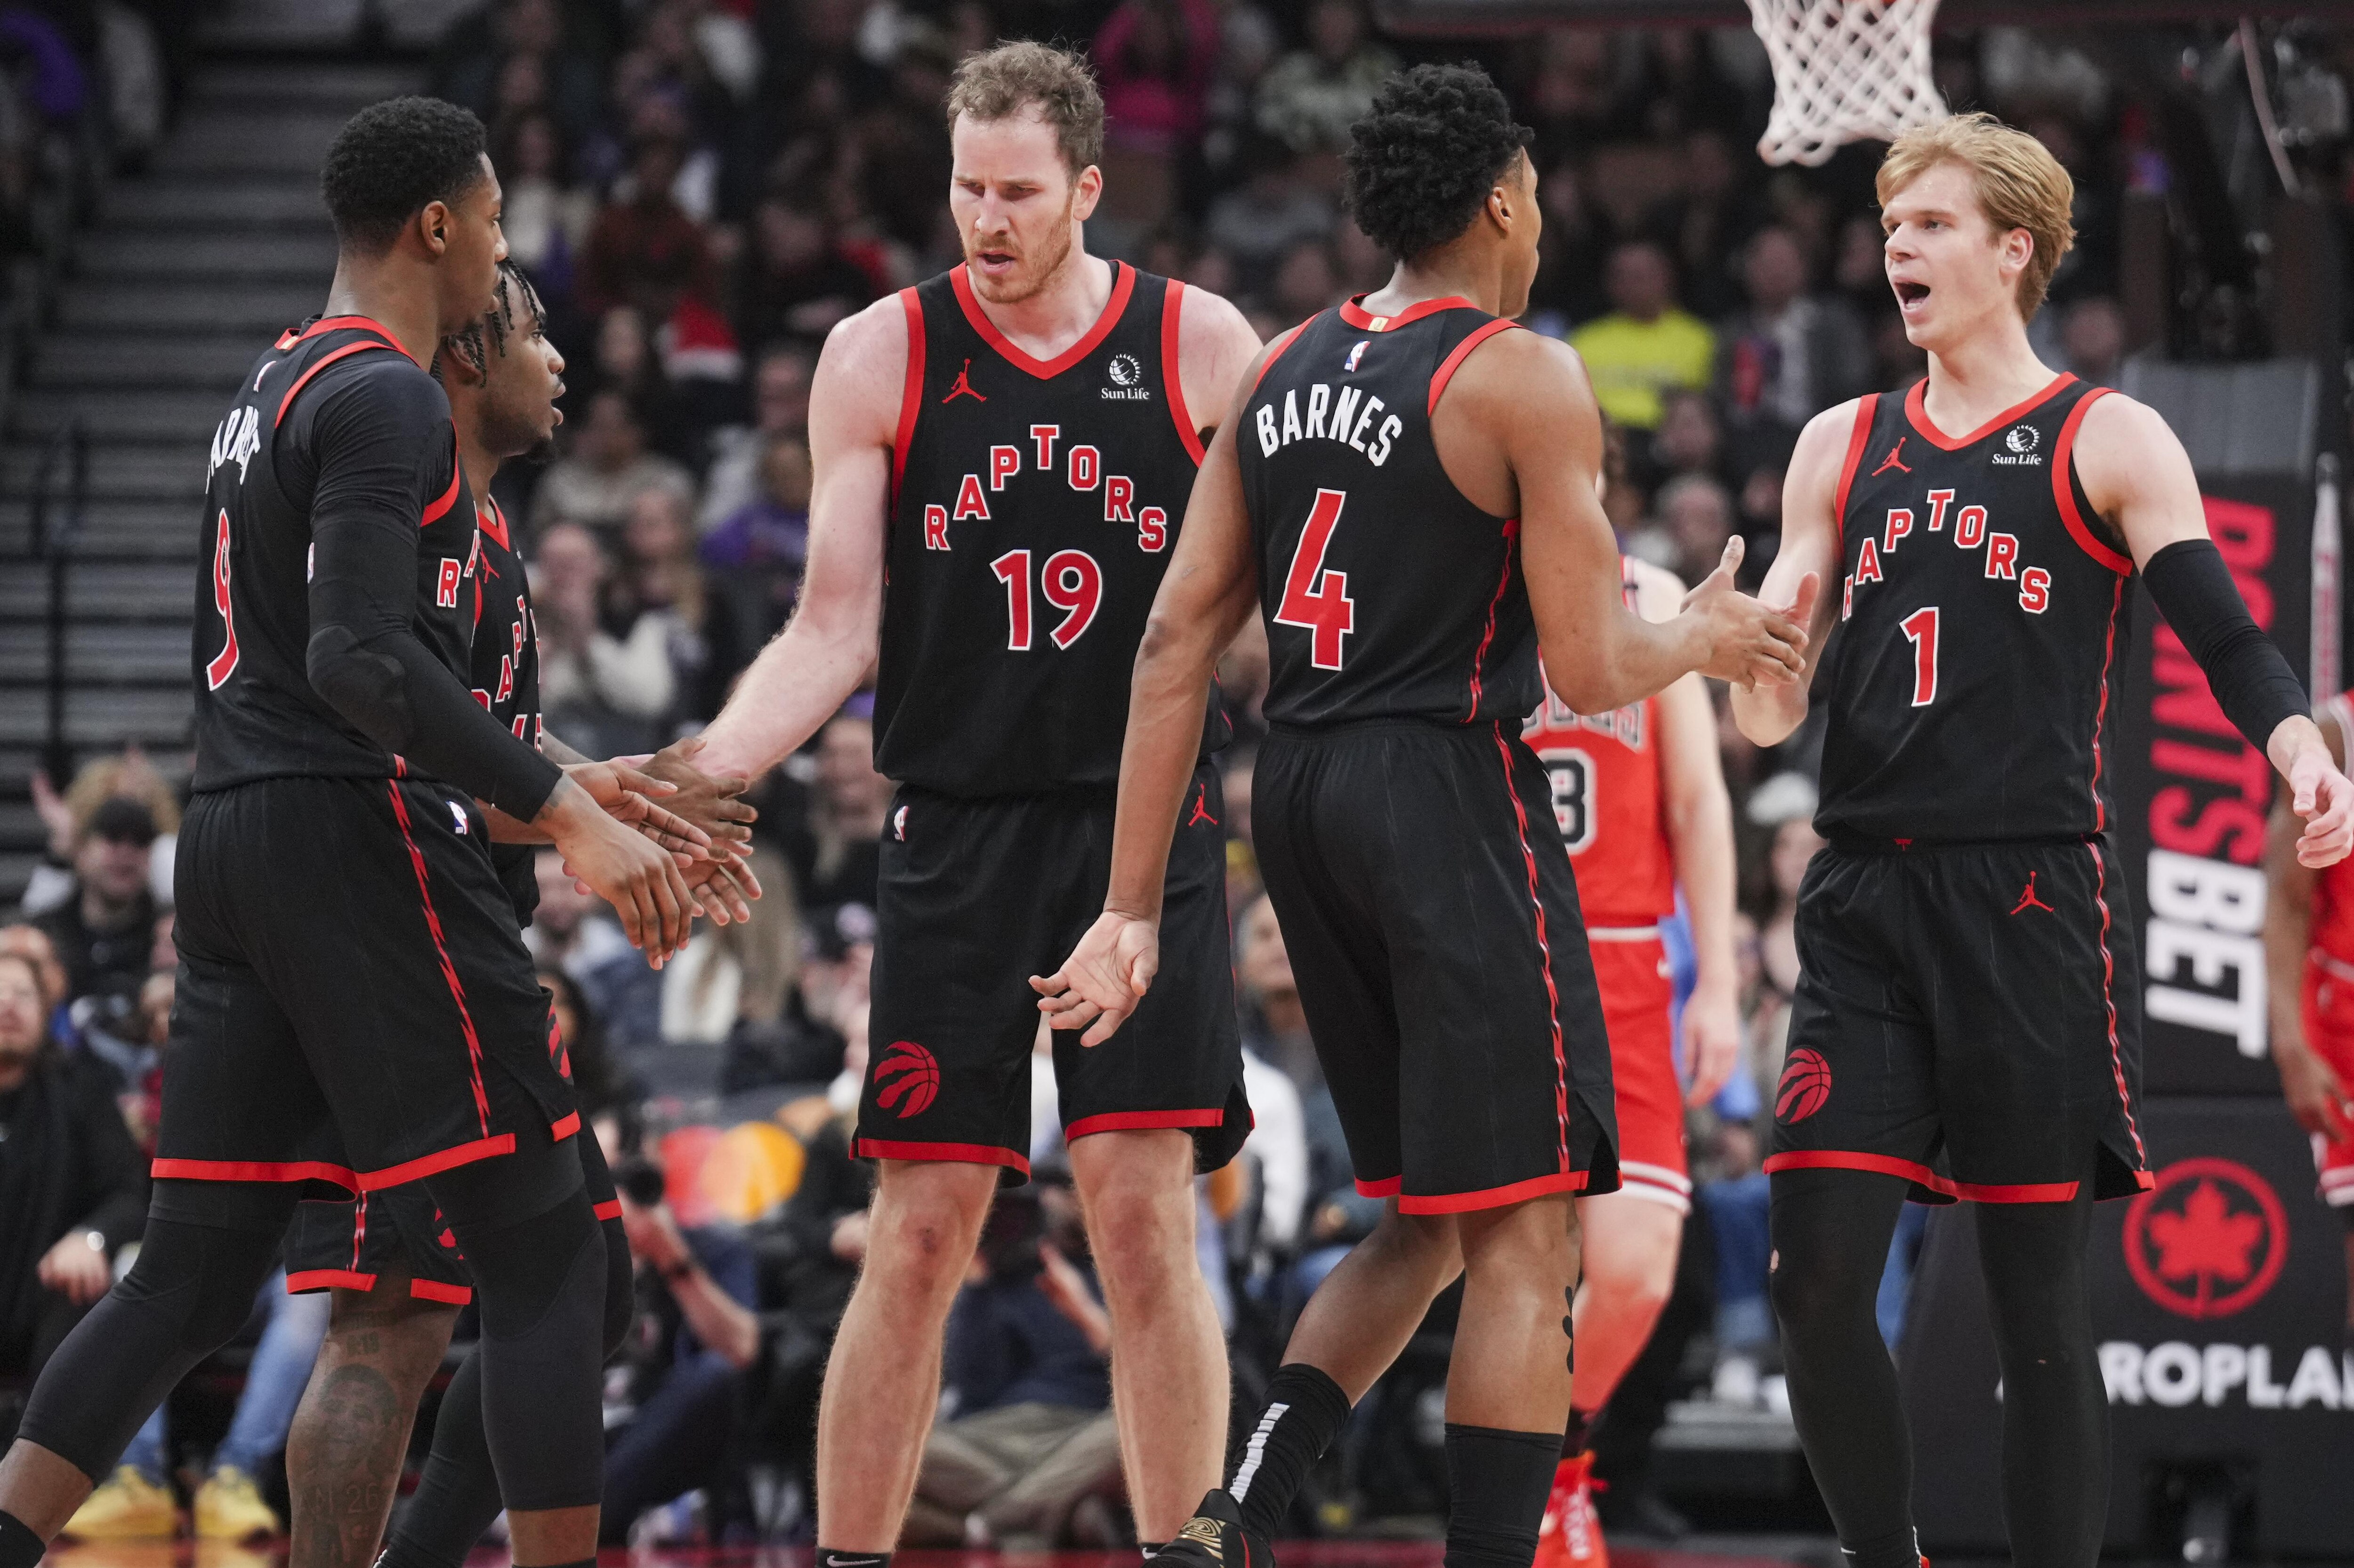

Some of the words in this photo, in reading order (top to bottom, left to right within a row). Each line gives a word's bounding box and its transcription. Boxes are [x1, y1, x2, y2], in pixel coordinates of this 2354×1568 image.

[1101, 387, 1125, 400] Sun
[1127, 387, 1150, 400] Life
[1256, 383, 1403, 467] BARNES
[924, 424, 1167, 552] RAPTORS
[1991, 453, 2016, 465] Sun
[2018, 453, 2042, 466] Life
[206, 507, 239, 691] 9
[989, 549, 1103, 651] 19
[1273, 488, 1354, 672] 4
[1841, 488, 2051, 622] RAPTORS
[1899, 606, 1939, 707] 1
